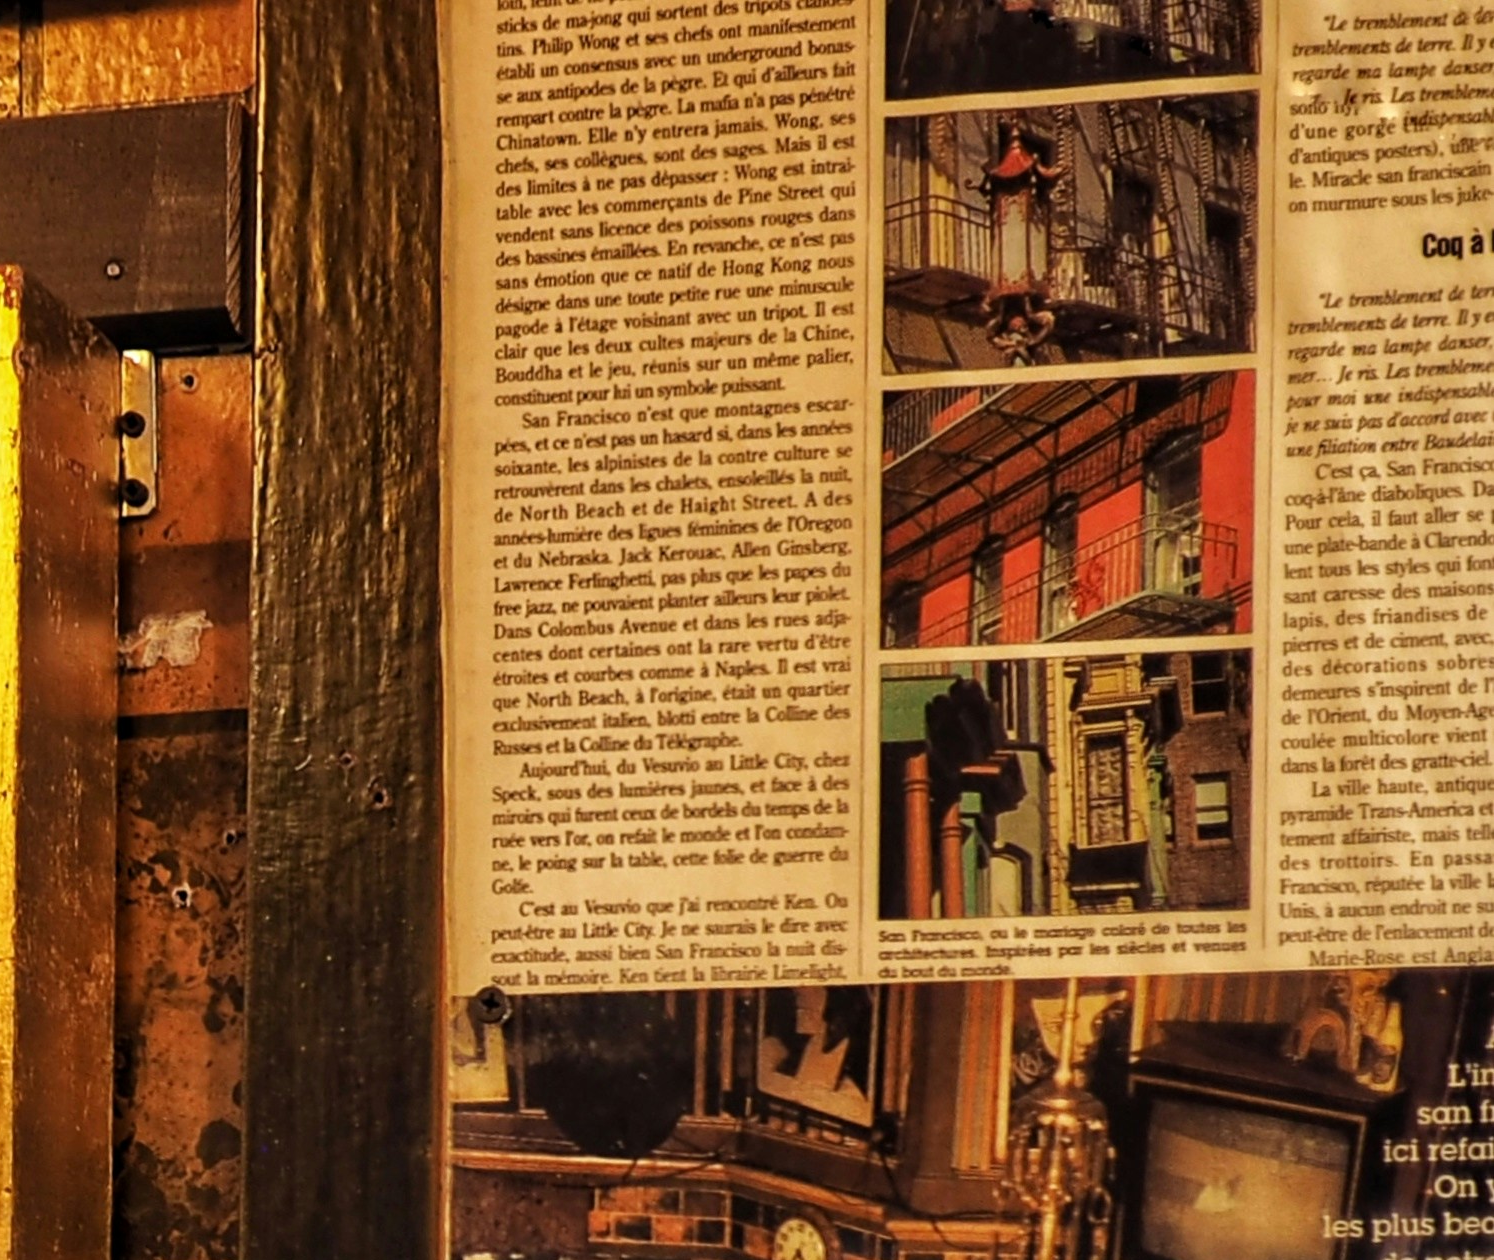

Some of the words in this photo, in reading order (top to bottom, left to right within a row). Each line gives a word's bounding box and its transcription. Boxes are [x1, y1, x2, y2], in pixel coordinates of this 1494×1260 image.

[532, 34, 574, 59] Philip
[578, 31, 621, 56] Wong
[624, 30, 640, 48] et
[644, 34, 669, 46] ses
[673, 24, 714, 44] chefs
[718, 22, 742, 41] ont
[587, 124, 618, 143] Elle
[623, 123, 648, 146] n'y
[651, 118, 710, 139] entrera
[829, 115, 857, 127] ses
[544, 158, 569, 171] ses
[653, 144, 685, 163] sont
[690, 142, 718, 161] des
[774, 136, 812, 155] Mais
[817, 135, 828, 153] il
[832, 133, 856, 152] est
[495, 201, 533, 220] table
[538, 204, 572, 217] avec
[577, 197, 600, 215] les
[712, 188, 733, 206] de
[738, 186, 773, 205] Pine
[777, 182, 825, 202] Street
[829, 180, 856, 204] qui
[495, 223, 555, 243] vendent
[559, 226, 595, 239] sans
[598, 217, 652, 237] licence
[656, 215, 685, 233] des
[688, 211, 757, 237] poissons
[760, 213, 814, 232] rouges
[818, 205, 856, 224] dans
[1422, 234, 1464, 259] Coq
[494, 341, 528, 359] clair
[533, 345, 563, 362] que
[567, 338, 590, 356] les
[594, 335, 633, 354] deux
[638, 333, 685, 352] cultes
[690, 329, 753, 354] majeurs
[757, 328, 778, 346] de
[783, 327, 797, 344] la
[521, 409, 551, 428] San
[556, 405, 632, 426] Francisco
[636, 403, 674, 422] n'est
[679, 408, 710, 425] que
[714, 397, 802, 423] montagnes
[805, 400, 854, 414] escar-
[492, 551, 508, 568] et
[513, 550, 533, 568] du
[618, 545, 653, 564] Jack
[731, 541, 771, 559] Allen
[493, 572, 564, 592] Lawrence
[660, 573, 687, 590] pas
[690, 566, 724, 589] plus
[725, 571, 754, 588] que
[758, 564, 780, 582] les
[783, 568, 828, 586] papes
[831, 561, 852, 579] du
[615, 756, 637, 774] du
[642, 755, 701, 773] Vesuvio
[704, 760, 725, 771] au
[729, 753, 769, 771] Little
[813, 750, 851, 768] chez
[1416, 1105, 1472, 1125] san
[1383, 1138, 1420, 1163] ici
[1434, 1174, 1478, 1198] On
[1322, 1214, 1364, 1238] les
[1370, 1212, 1436, 1243] plus
